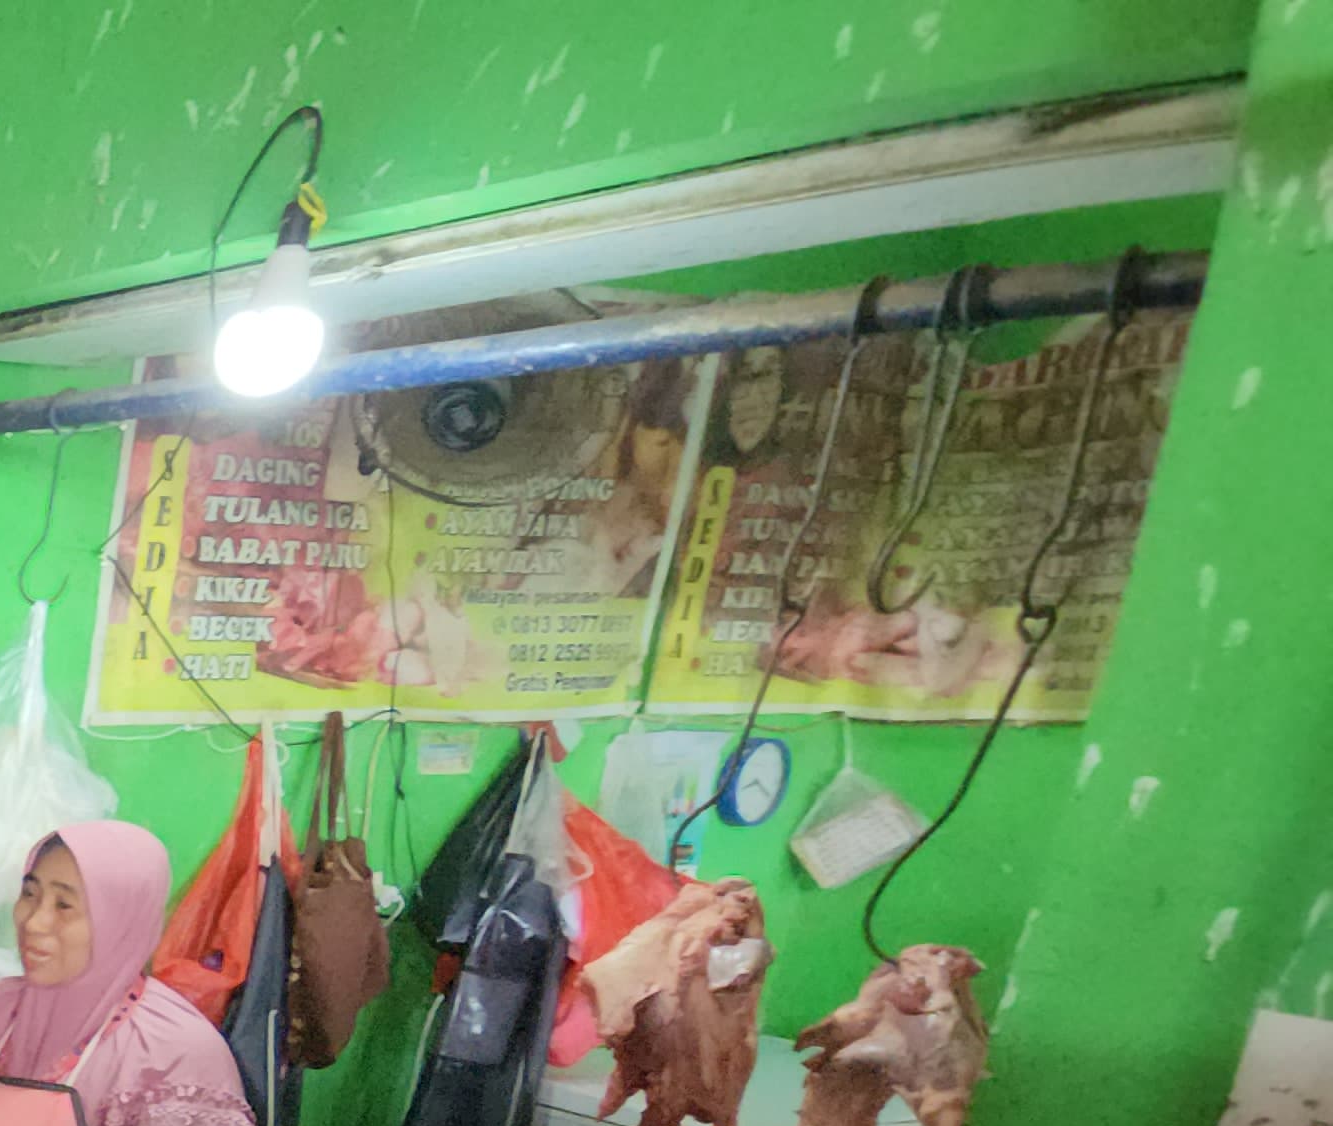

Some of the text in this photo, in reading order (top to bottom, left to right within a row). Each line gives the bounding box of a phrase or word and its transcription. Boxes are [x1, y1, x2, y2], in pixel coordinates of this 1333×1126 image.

[211, 453, 321, 486] DAGING
[204, 495, 370, 530] TULANG IGA
[438, 509, 516, 536] AYAM
[198, 535, 370, 568] BABAT PARU
[195, 575, 273, 603] KIKIL
[188, 615, 276, 641] BECEK
[181, 653, 251, 681] HATI
